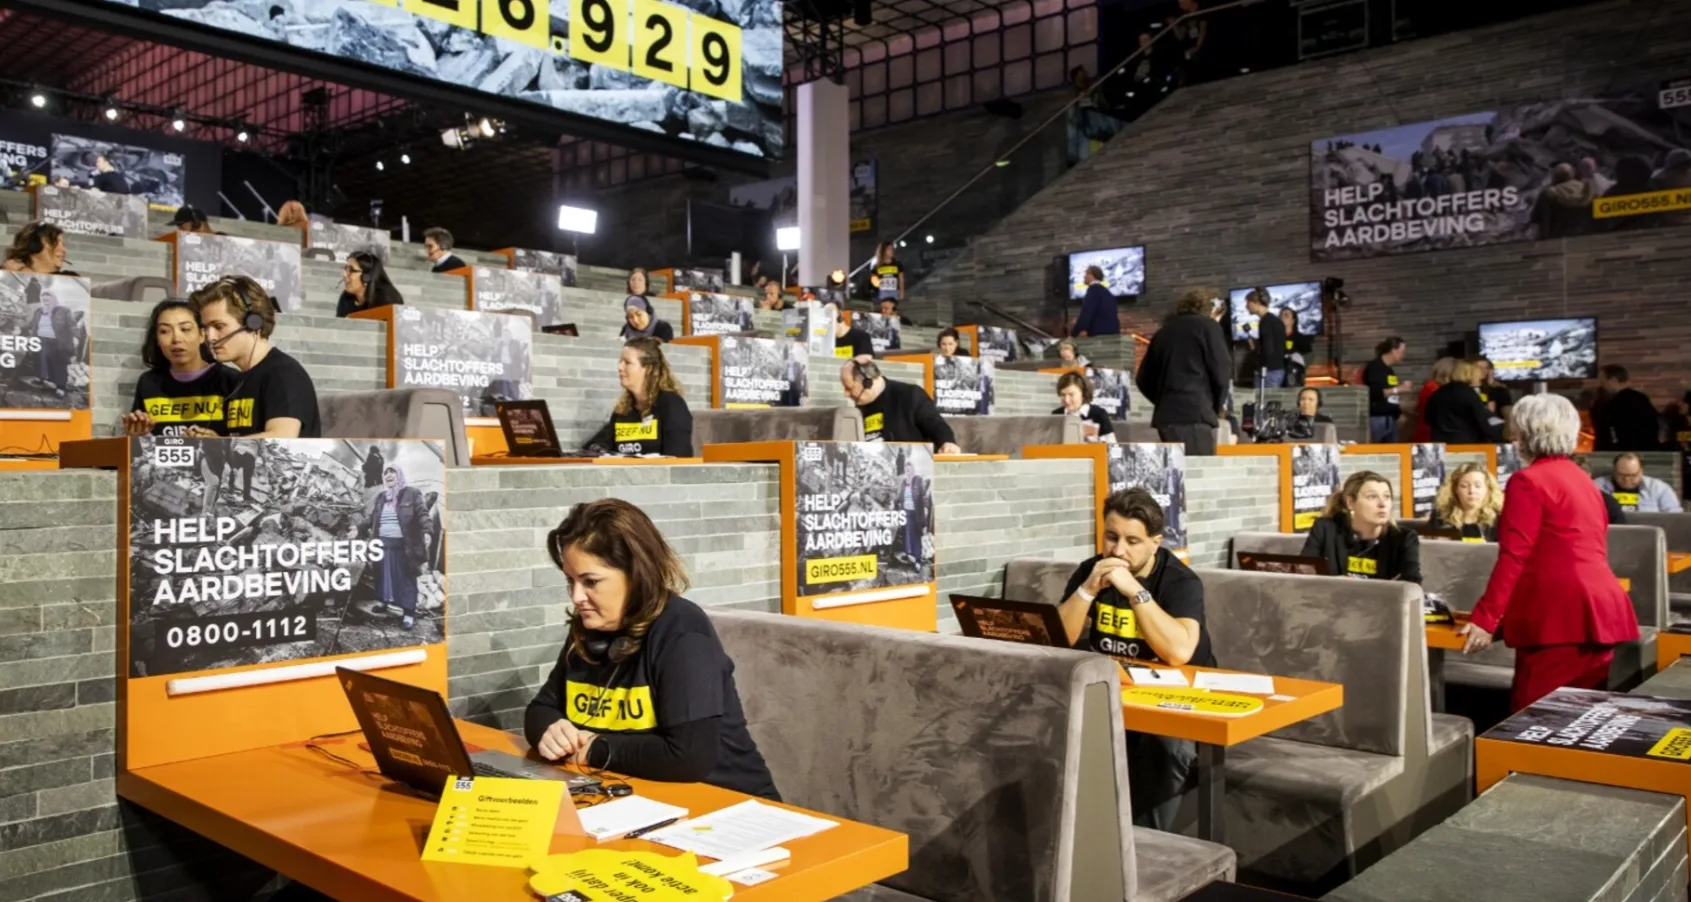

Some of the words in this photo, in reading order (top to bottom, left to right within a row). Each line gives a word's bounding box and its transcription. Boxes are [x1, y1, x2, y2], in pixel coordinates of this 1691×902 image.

[1663, 89, 1691, 105] 55
[1324, 183, 1384, 208] HELP
[1324, 186, 1519, 227] SLACHTOFFERS
[1324, 213, 1485, 248] AARDBEVING
[185, 261, 217, 273] HELP
[404, 343, 439, 357] HELP
[404, 357, 504, 375] SLACHTOFFERS
[404, 372, 489, 387] AARDBEVING
[150, 402, 190, 416] GEEF
[194, 402, 217, 414] NU
[158, 449, 191, 463] 555
[804, 494, 840, 511] HELP
[805, 510, 907, 530] SLACHTOFFERS
[154, 517, 236, 544] HELP
[805, 529, 892, 551] AARDBEVING
[154, 538, 384, 574] SLACHTOFFERS
[810, 562, 874, 578] GIRO555.NL
[152, 569, 351, 605] AARDBEVING
[166, 616, 307, 648] 0800-1112
[1100, 637, 1139, 656] GIRO
[627, 880, 656, 893] ook
[660, 876, 698, 895] actie
